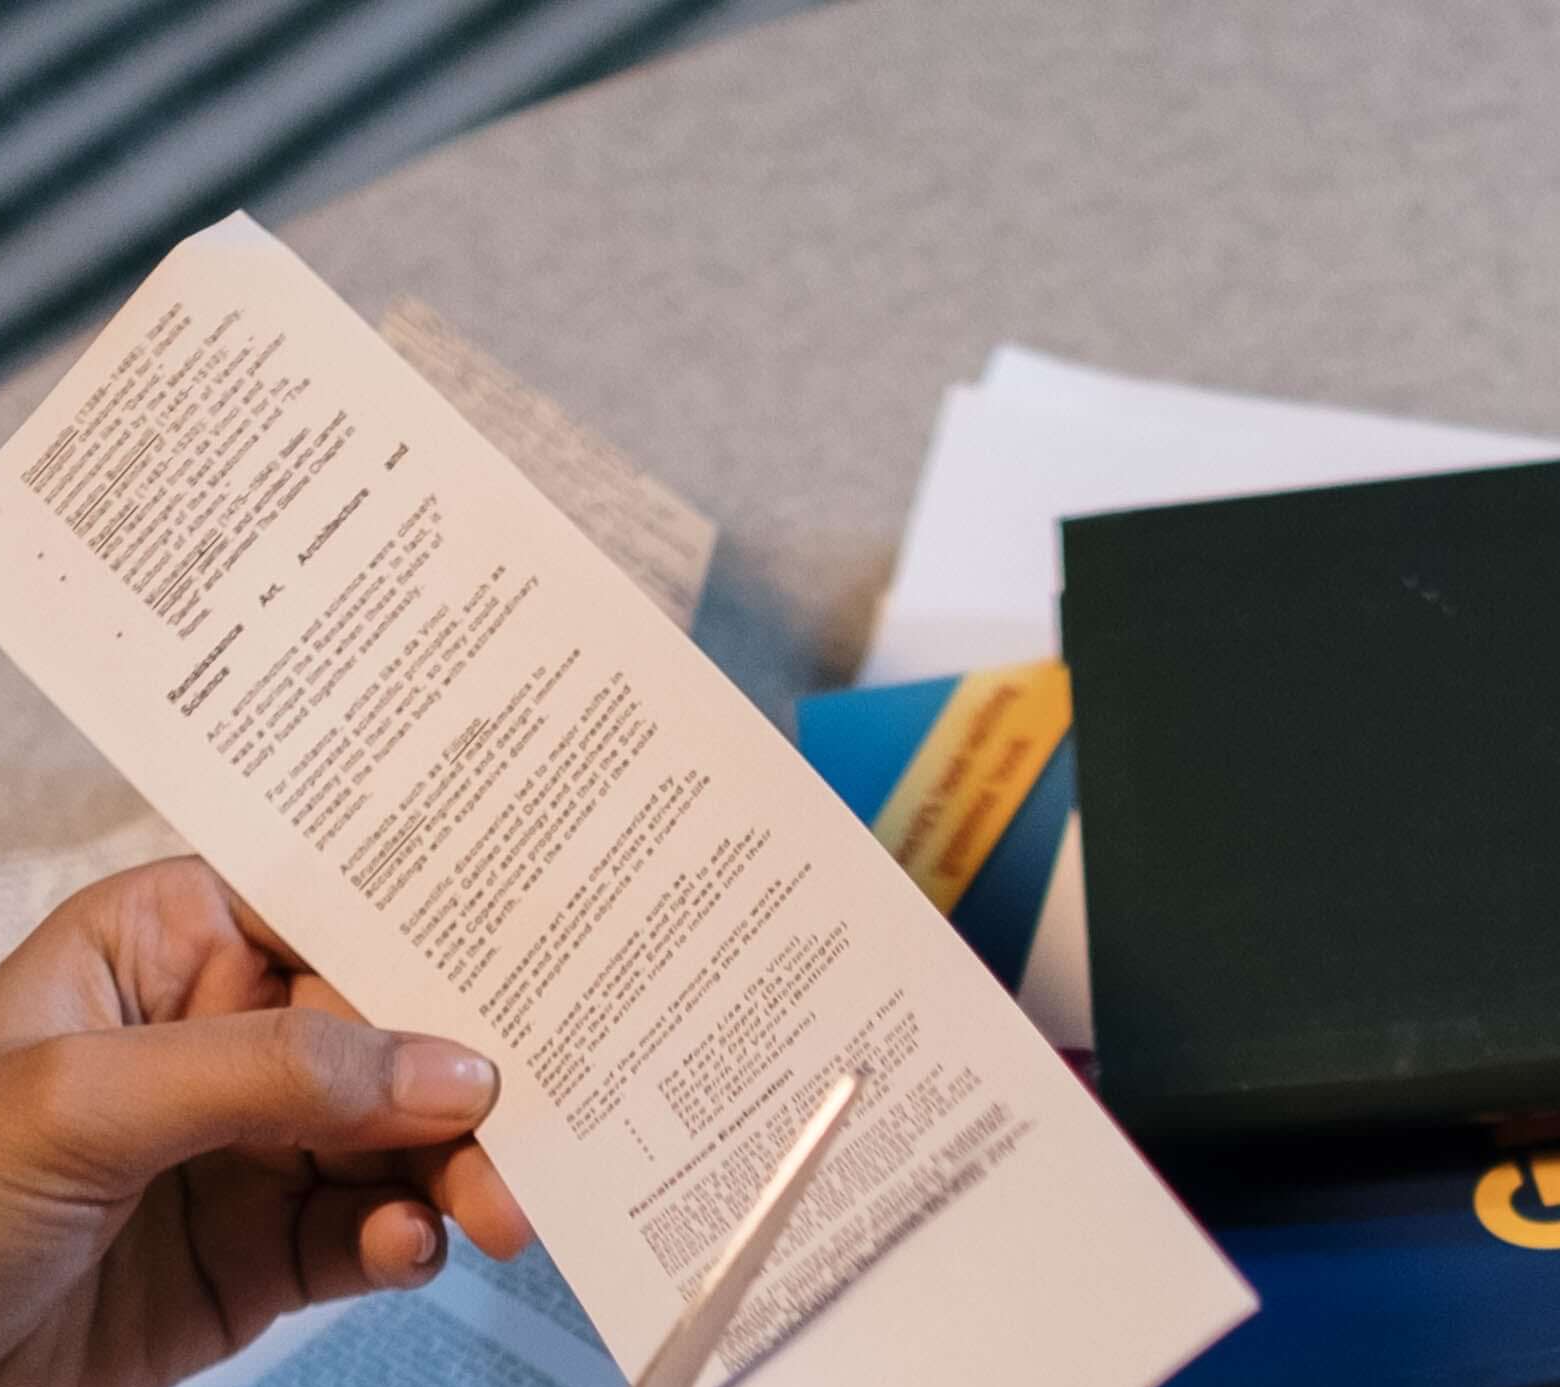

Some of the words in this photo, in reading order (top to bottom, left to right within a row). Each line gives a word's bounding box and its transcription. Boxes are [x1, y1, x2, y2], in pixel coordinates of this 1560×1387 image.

[143, 527, 224, 611] Michelangelo
[166, 623, 244, 704] Renaissance
[296, 487, 370, 567] Architecture
[383, 441, 410, 471] and
[179, 665, 230, 717] Science
[338, 812, 399, 876] Architects
[397, 780, 427, 812] such
[427, 762, 443, 780] as
[441, 716, 490, 765] Filippo
[349, 809, 422, 887] Brunelleschi
[422, 760, 465, 810] studied
[464, 681, 533, 761] mathematics
[530, 665, 547, 681] to
